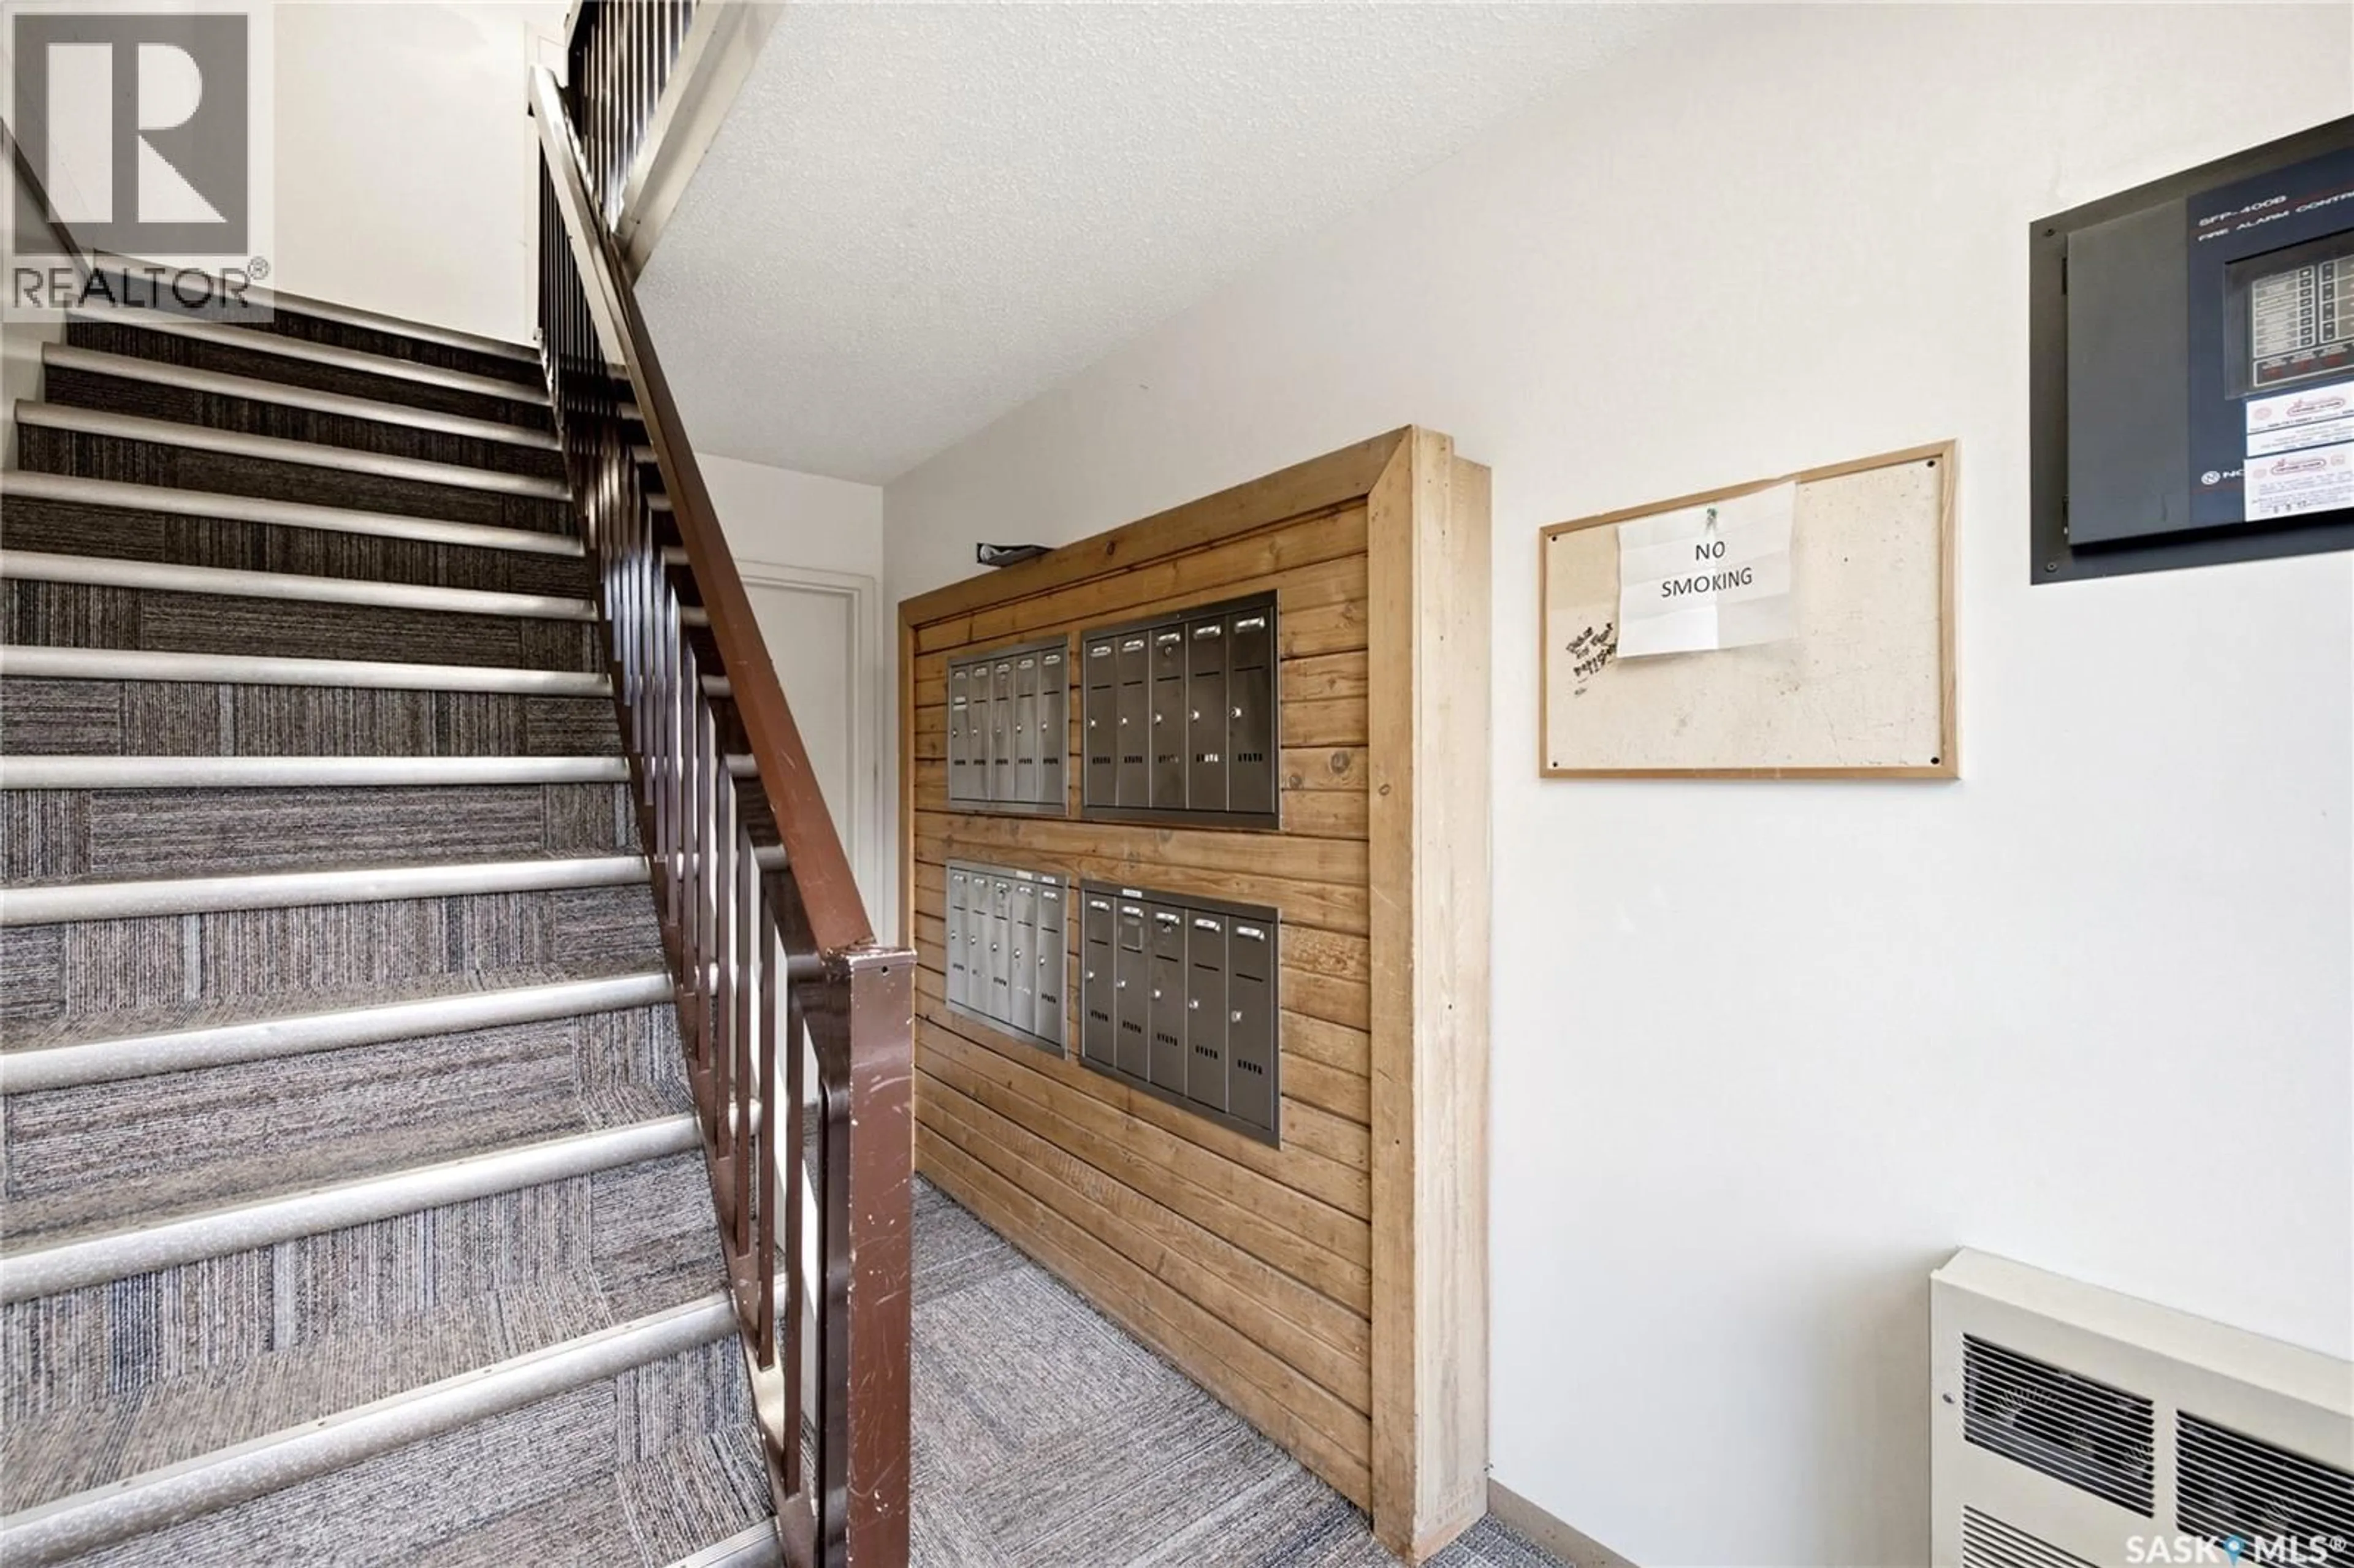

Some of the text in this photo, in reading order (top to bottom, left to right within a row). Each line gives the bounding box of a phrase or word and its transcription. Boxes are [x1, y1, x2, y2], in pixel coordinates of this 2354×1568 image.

[2198, 191, 2354, 242] FIRE ALARM CONTR
[1696, 541, 1726, 561] NO
[1661, 566, 1753, 598] SMOKING
